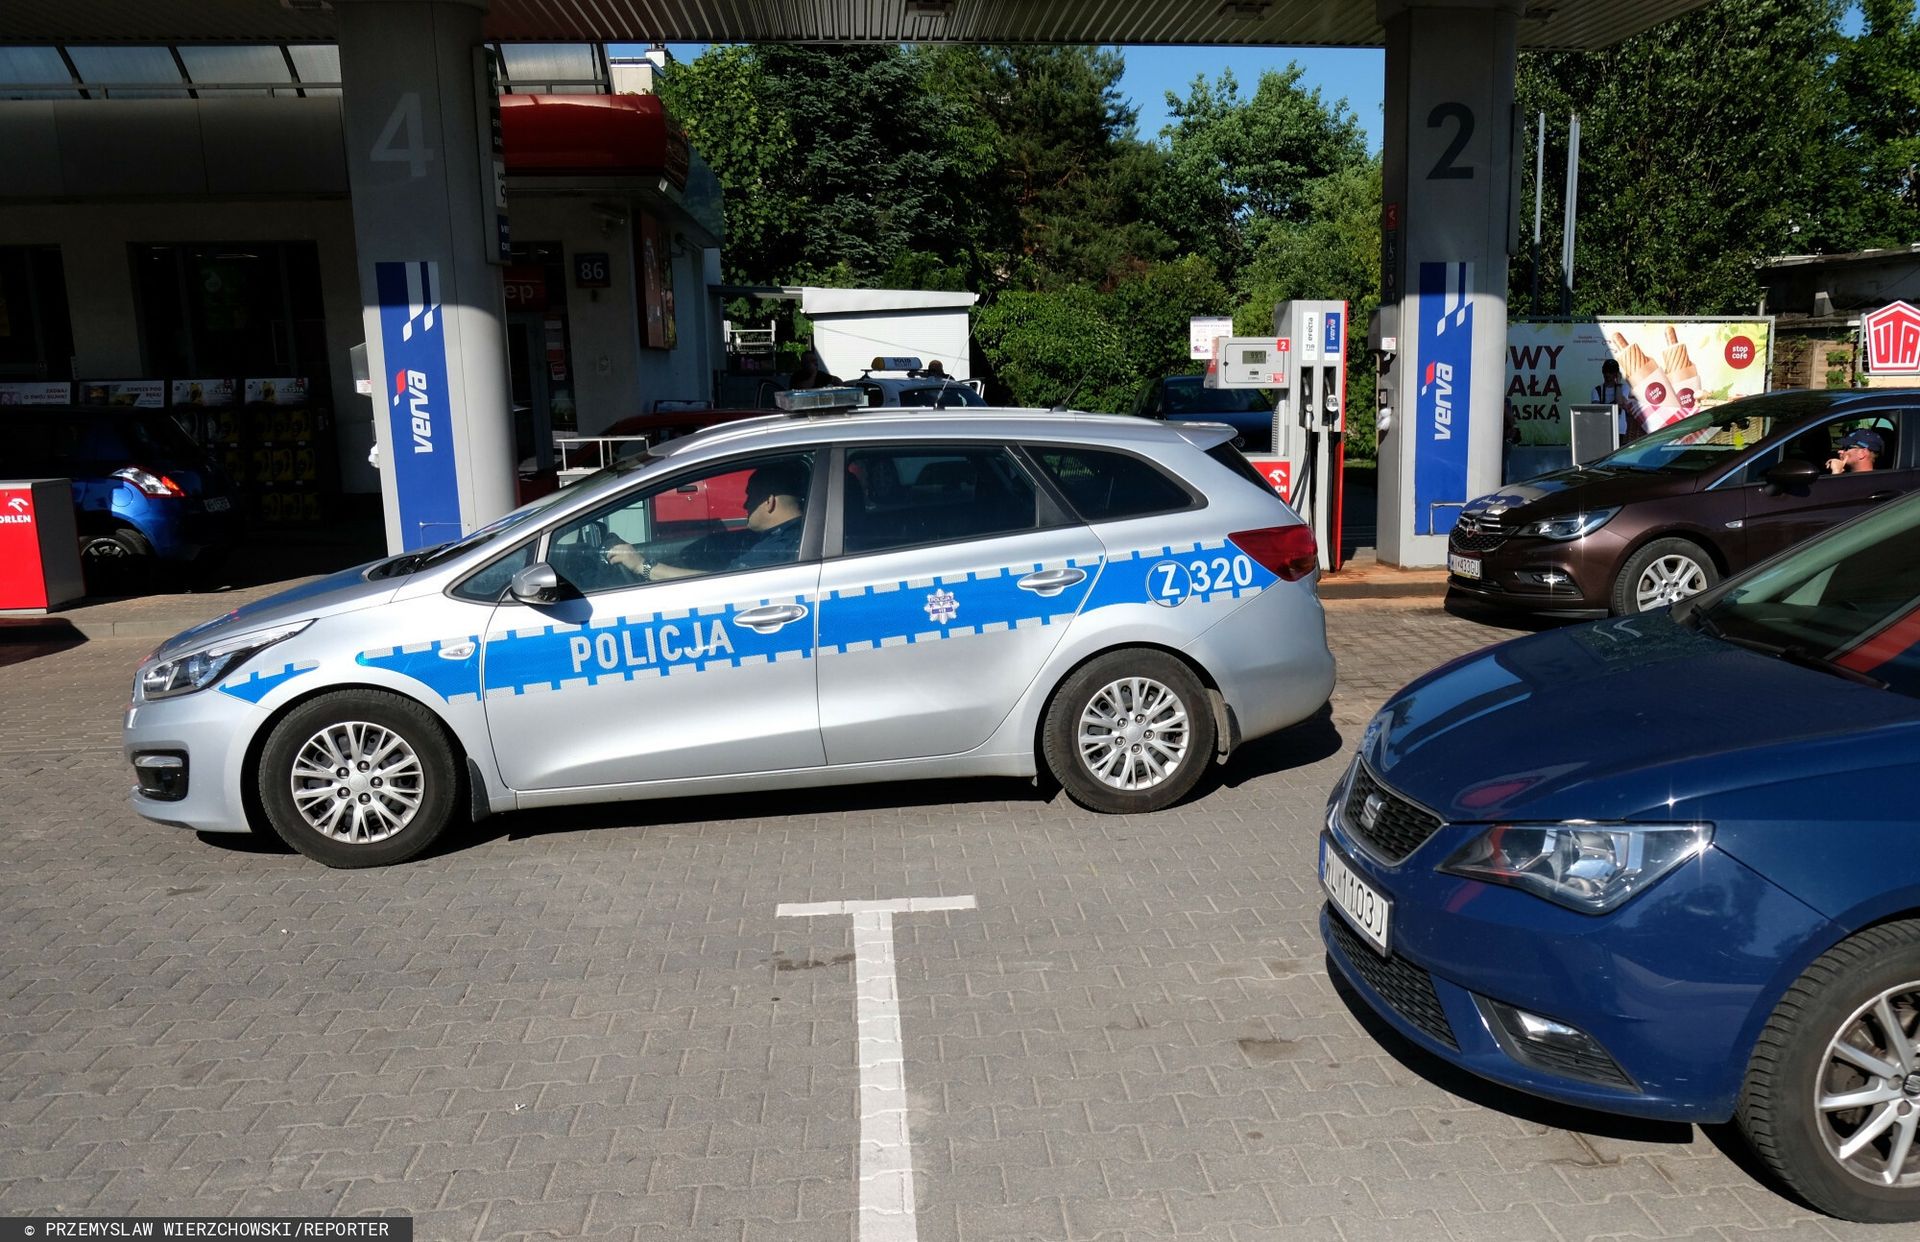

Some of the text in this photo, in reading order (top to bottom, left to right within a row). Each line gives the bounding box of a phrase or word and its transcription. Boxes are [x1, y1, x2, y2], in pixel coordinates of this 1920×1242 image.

[369, 92, 435, 177] 4
[1426, 102, 1475, 180] 2
[581, 262, 604, 280] 86
[504, 285, 534, 304] ep
[1280, 341, 1287, 350] 2
[1732, 345, 1749, 353] stop
[1873, 310, 1920, 364] UTA
[1505, 345, 1565, 370] WY
[1434, 362, 1453, 441] verva
[1506, 374, 1562, 402] AŁĄ
[407, 369, 434, 454] verva
[1511, 404, 1561, 424] ASKĄ
[1158, 554, 1253, 597] Z 320
[569, 619, 735, 673] POLICJA
